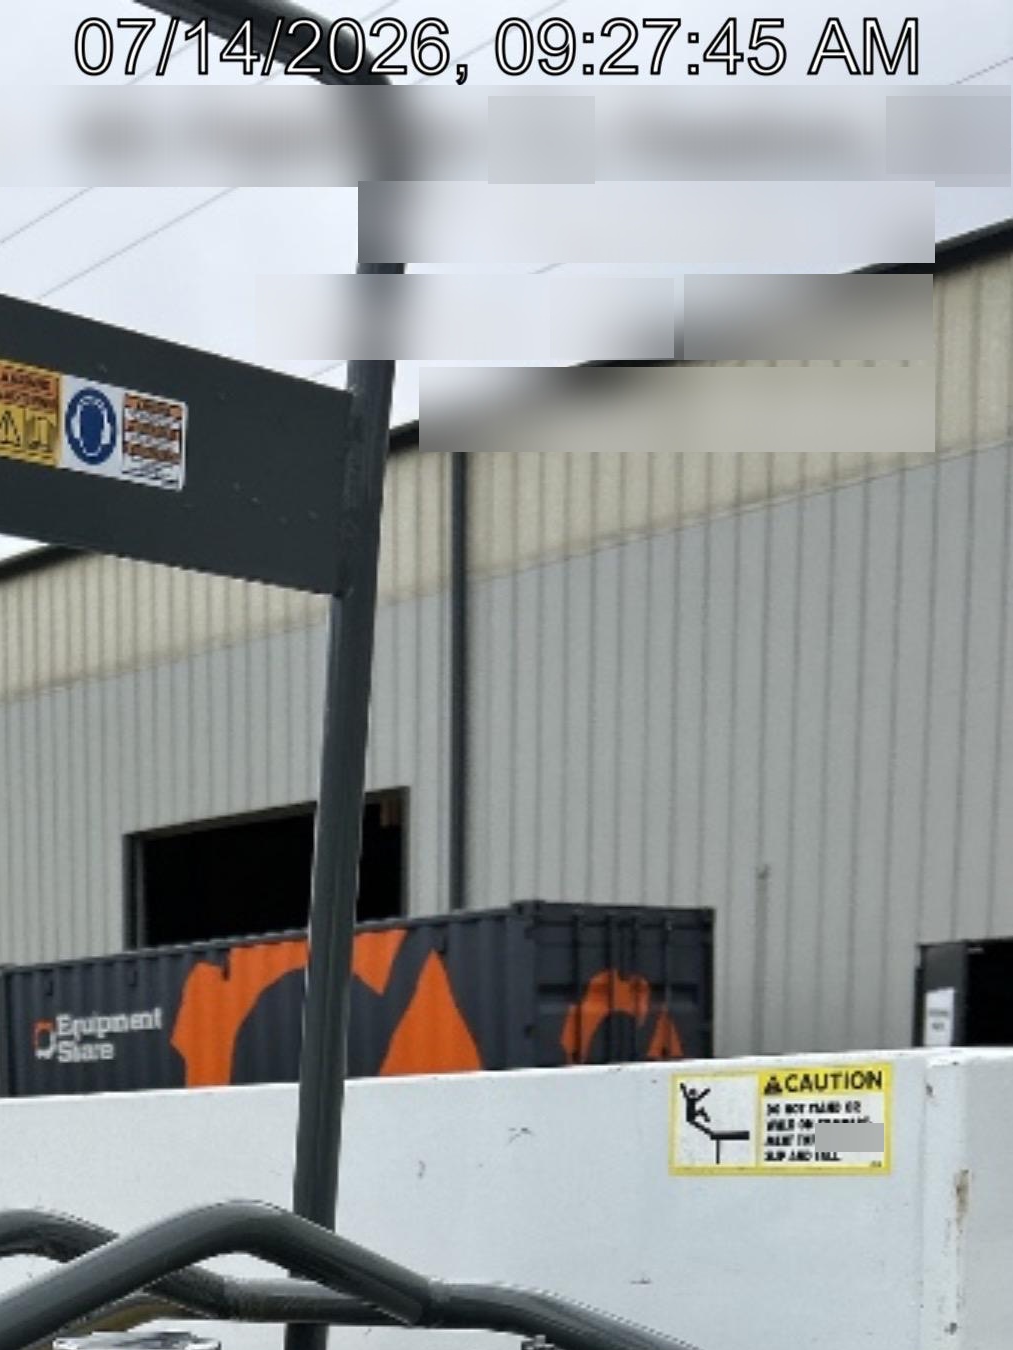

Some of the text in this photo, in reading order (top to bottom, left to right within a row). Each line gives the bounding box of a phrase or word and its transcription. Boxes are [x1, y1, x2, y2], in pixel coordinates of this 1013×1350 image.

[56, 1007, 163, 1042] Equipment
[57, 1040, 114, 1063] Share
[784, 1070, 883, 1093] CAUTION
